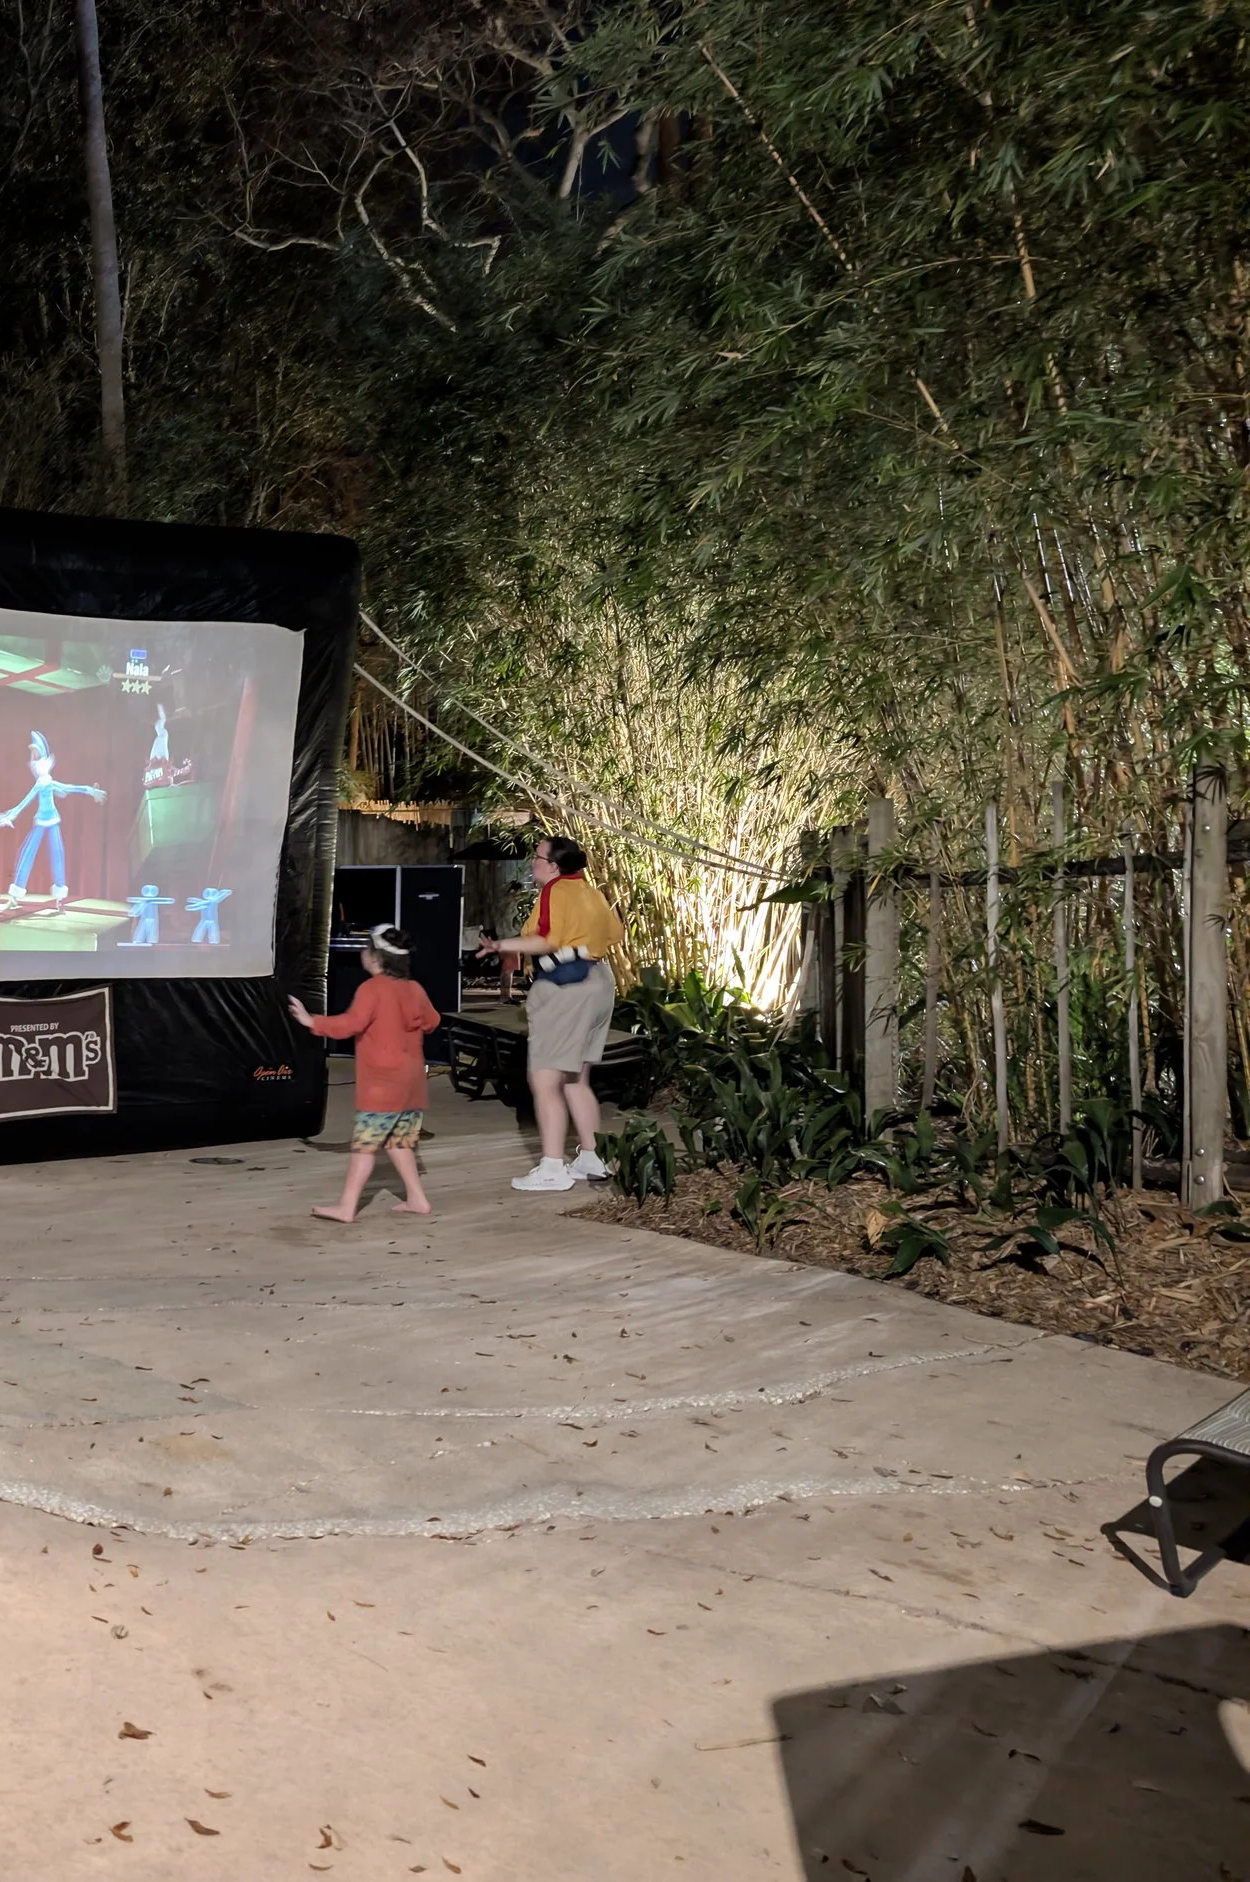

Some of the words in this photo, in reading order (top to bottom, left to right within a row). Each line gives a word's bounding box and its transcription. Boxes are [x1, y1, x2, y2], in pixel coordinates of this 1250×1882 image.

[126, 661, 150, 676] Nala
[10, 1024, 49, 1032] PRESENTED
[50, 1022, 60, 1031] BY
